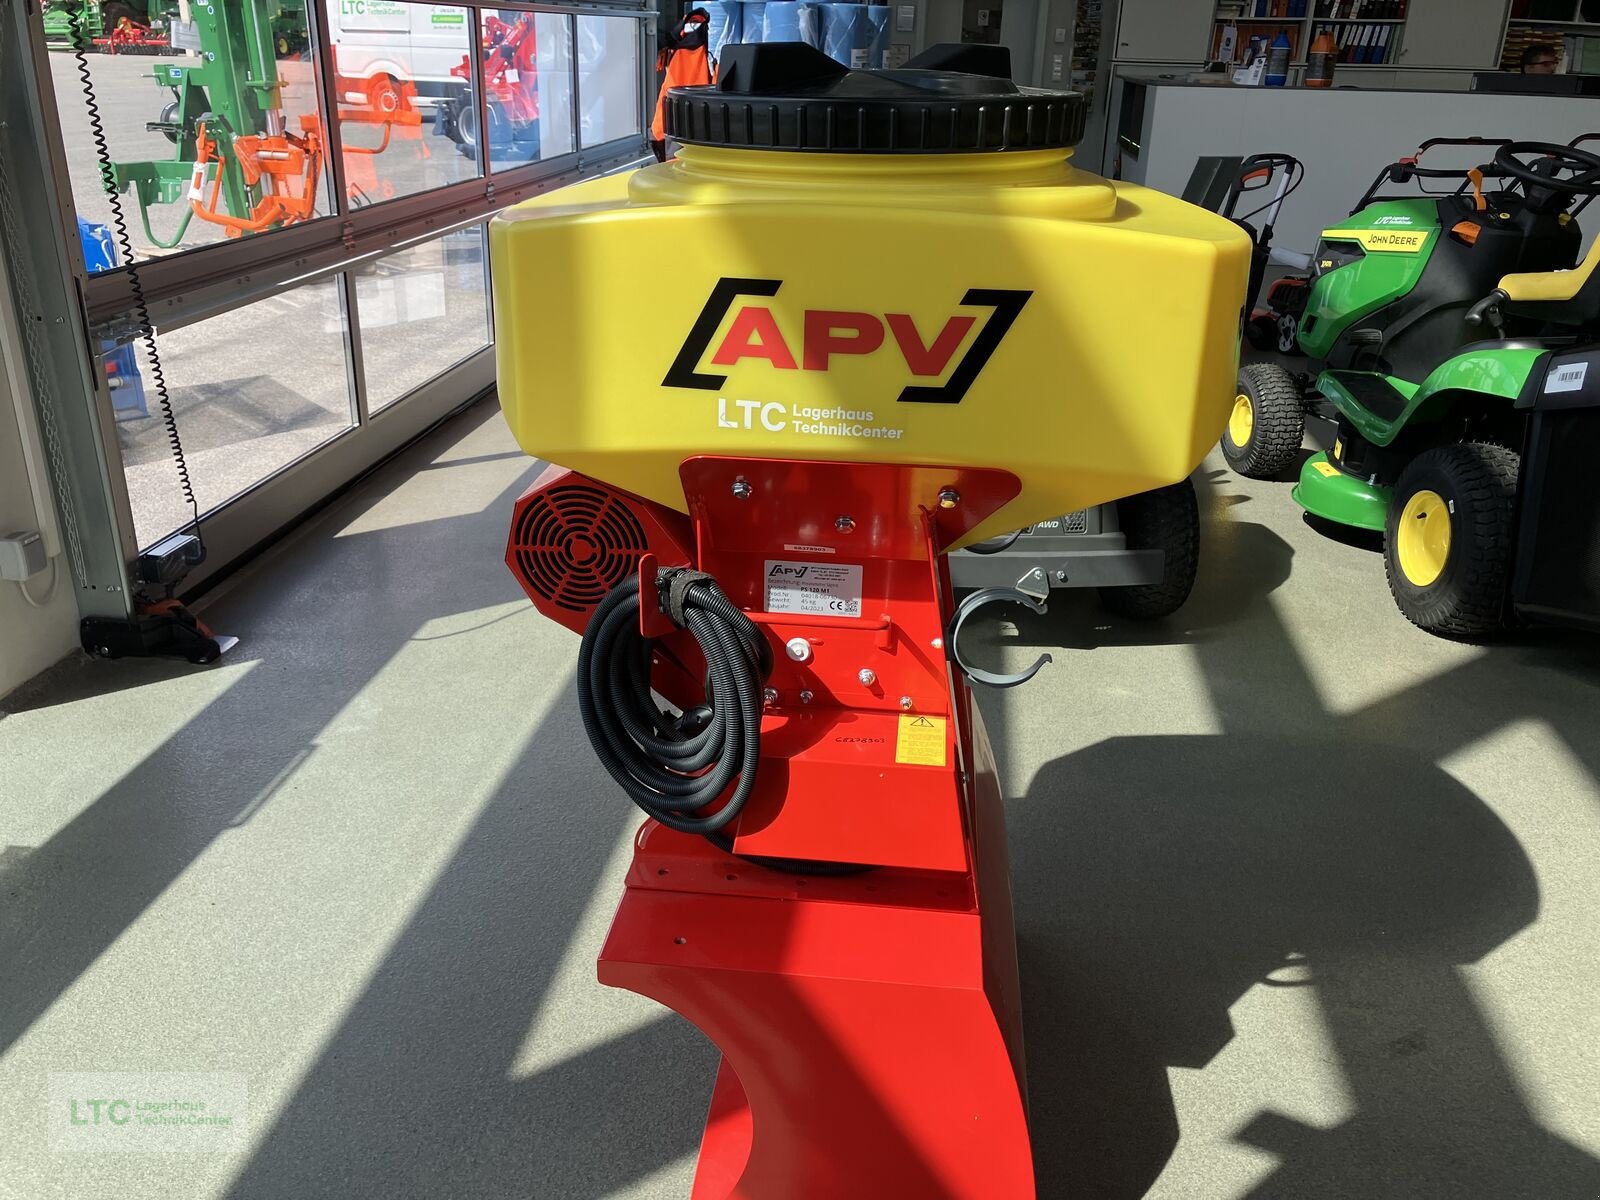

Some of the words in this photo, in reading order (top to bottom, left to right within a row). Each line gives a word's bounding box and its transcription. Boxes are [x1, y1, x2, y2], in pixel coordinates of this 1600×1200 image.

[341, 0, 365, 14] LTC
[1368, 234, 1387, 243] JOHN
[1389, 235, 1418, 245] DEERE
[717, 398, 787, 432] LTC
[792, 403, 874, 422] Lagerhaus
[792, 420, 904, 440] TechnikCenter
[1037, 521, 1059, 529] AWD
